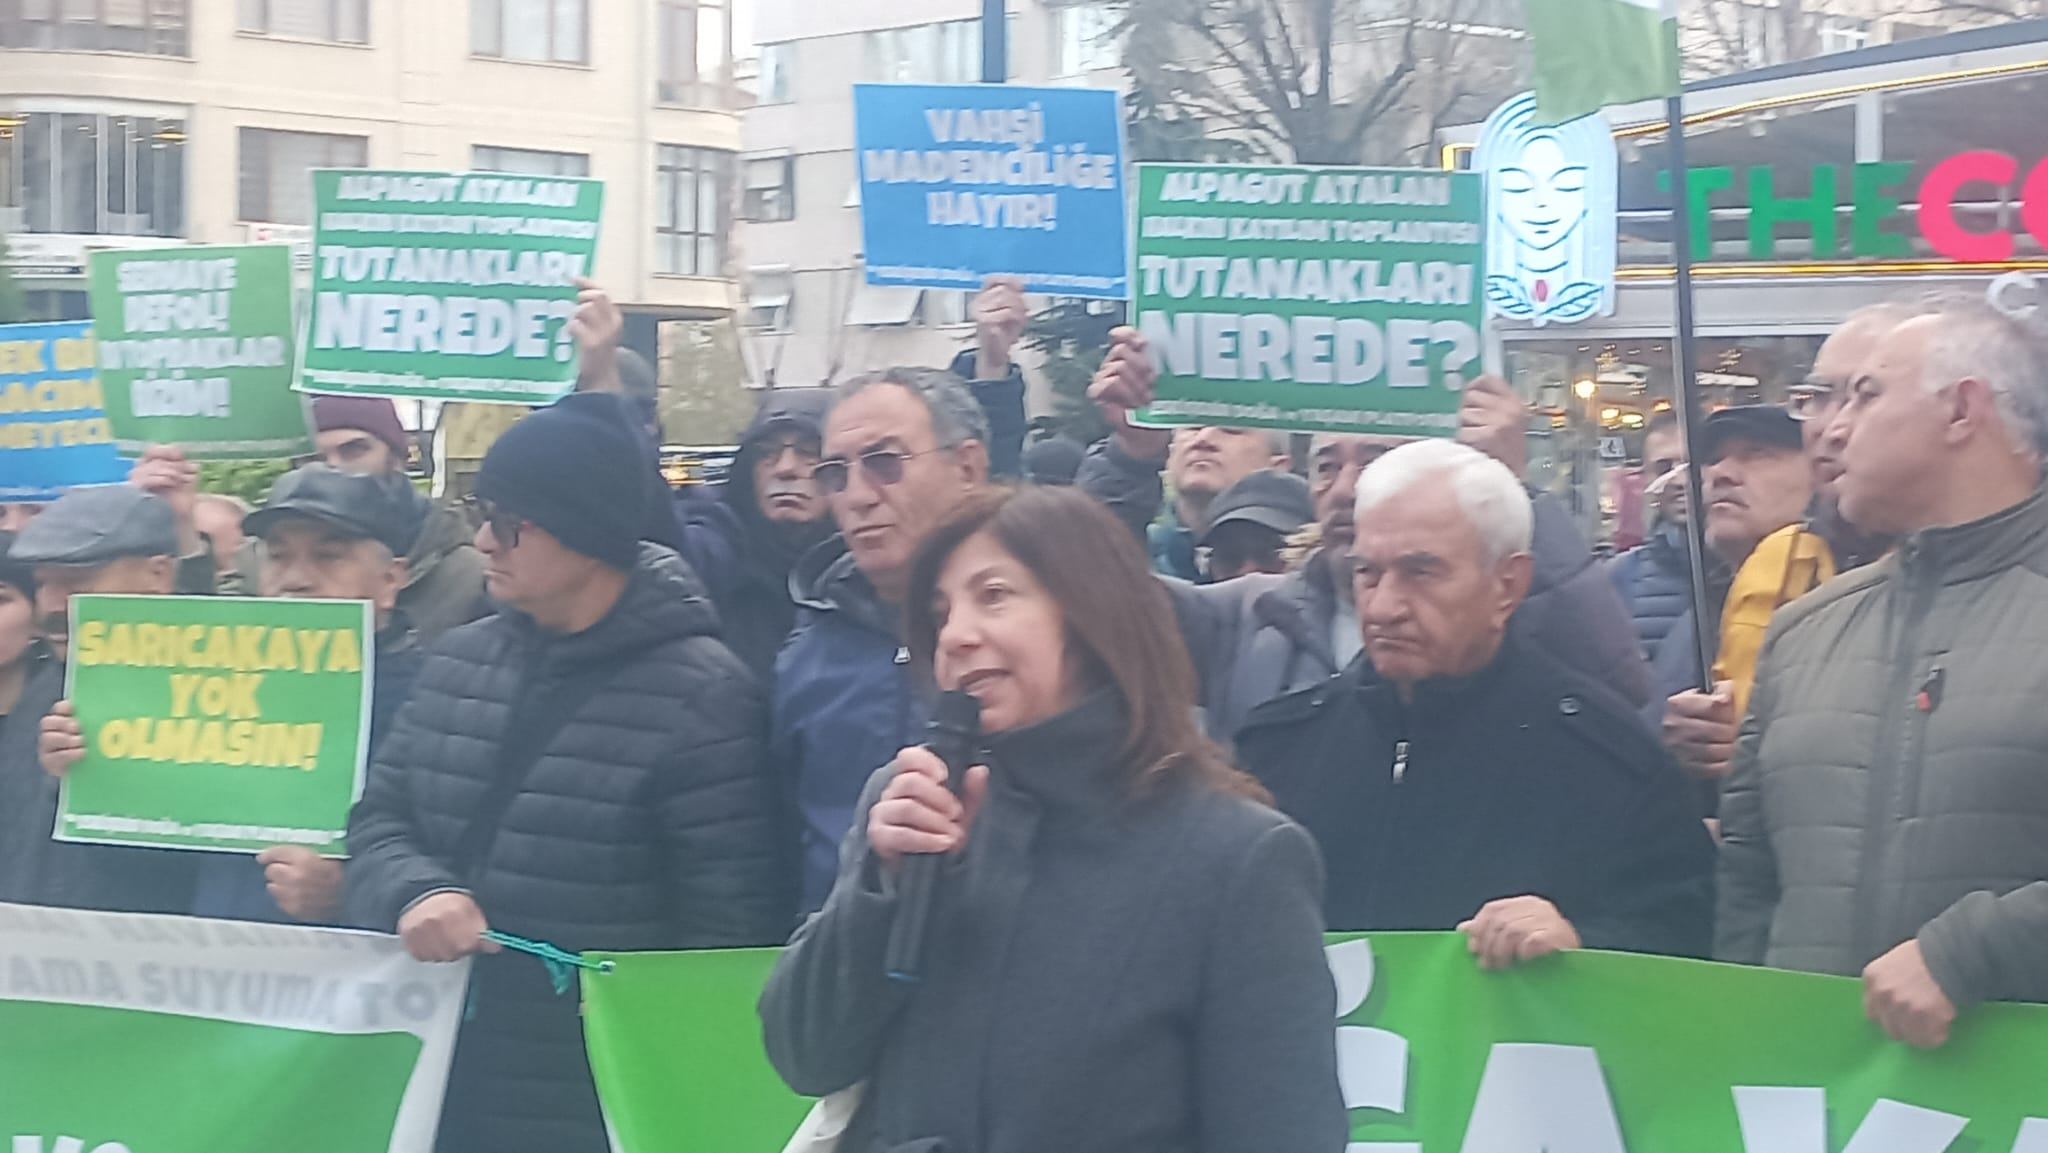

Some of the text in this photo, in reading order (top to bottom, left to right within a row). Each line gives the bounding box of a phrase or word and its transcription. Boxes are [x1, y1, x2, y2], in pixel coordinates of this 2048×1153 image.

[924, 101, 1044, 151] VAHŞİ
[863, 142, 1116, 190] MADENCİLİĞE
[1160, 172, 1449, 207] ALPAGUT ATALAN
[926, 191, 1056, 231] HAYIR!
[319, 245, 587, 287] TUTANAKLARI
[1139, 255, 1473, 305] TUTANAKLARI
[314, 291, 576, 362] NEREDE?
[1140, 310, 1480, 392] NEREDE?
[78, 620, 361, 673] SARICAKAYA
[169, 672, 265, 720] YOK
[98, 717, 323, 771] OLMASIN!
